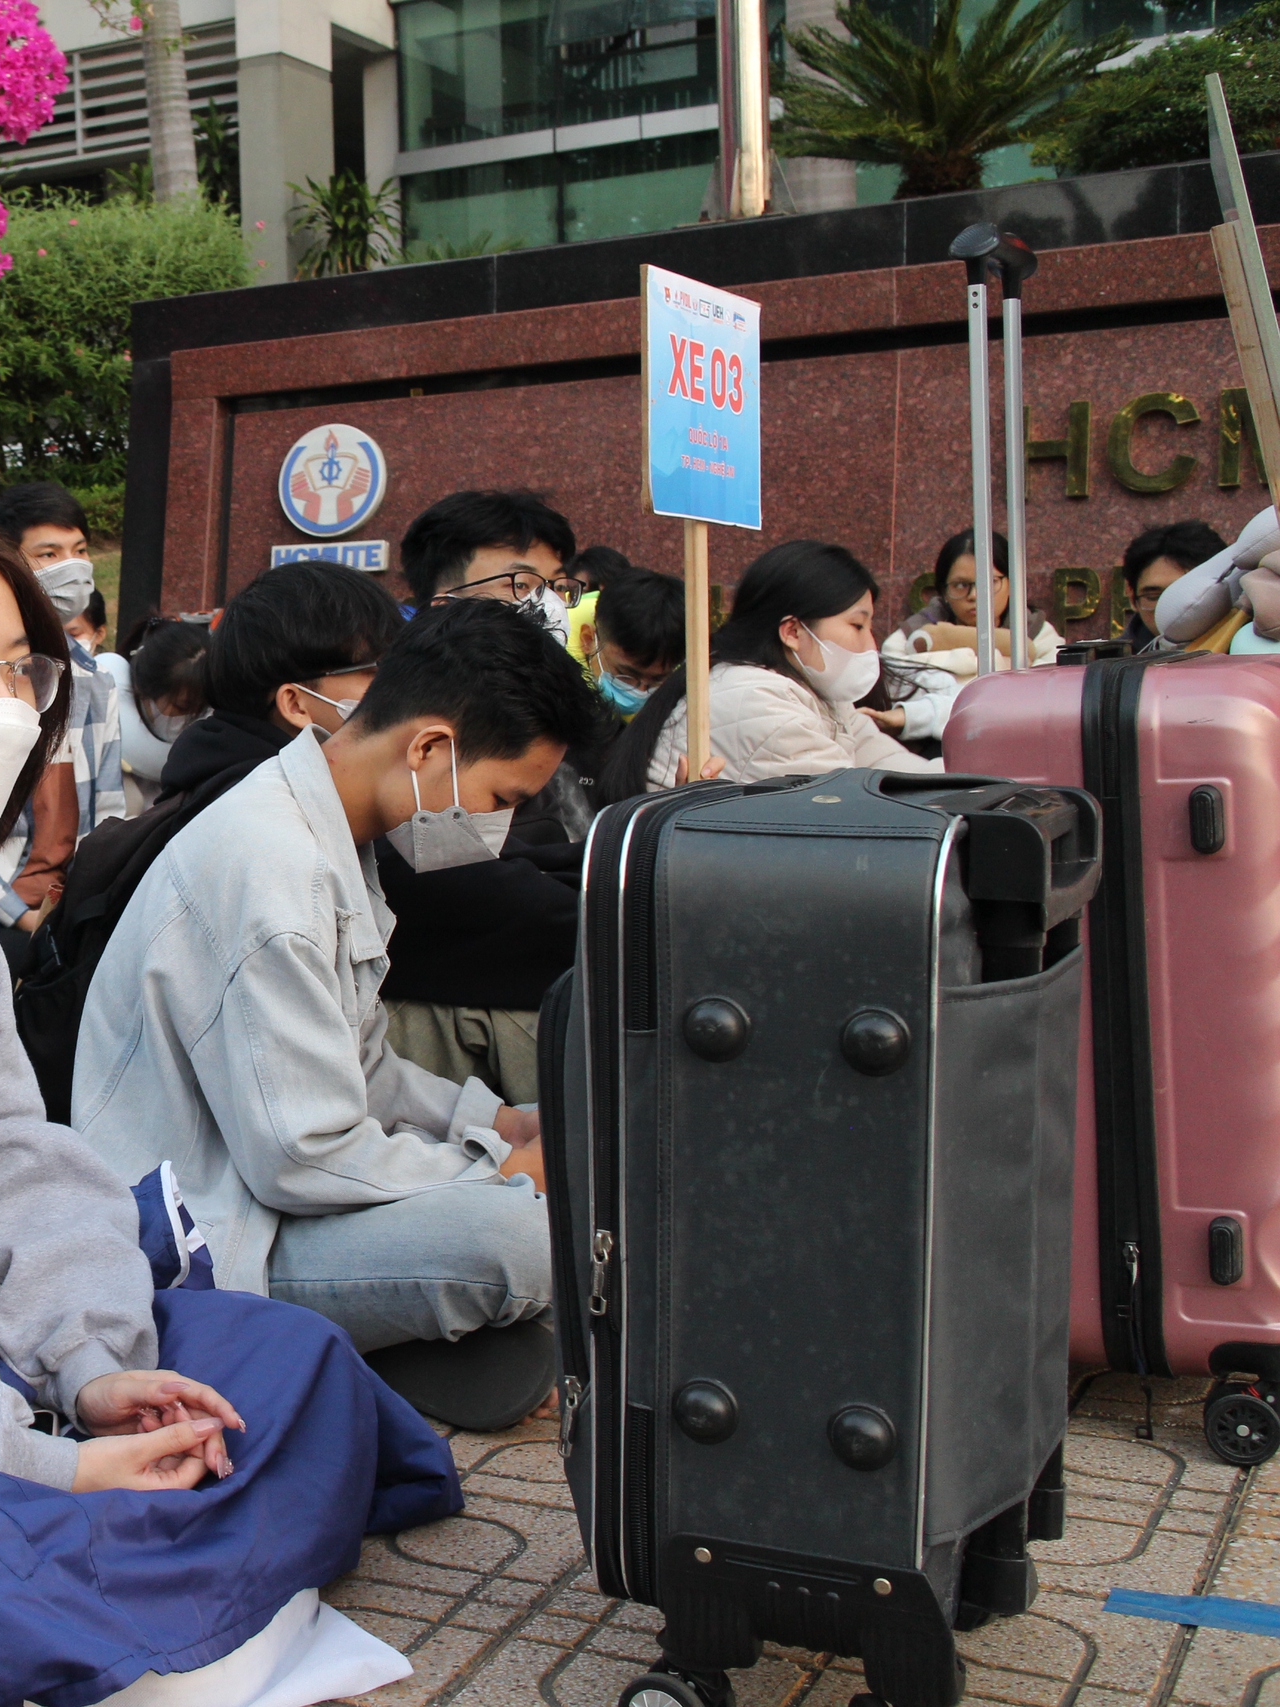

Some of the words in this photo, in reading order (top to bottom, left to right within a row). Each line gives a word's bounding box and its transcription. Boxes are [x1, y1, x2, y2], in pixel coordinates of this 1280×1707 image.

[713, 303, 724, 320] UEH
[668, 332, 706, 404] XE
[710, 346, 744, 415] 03
